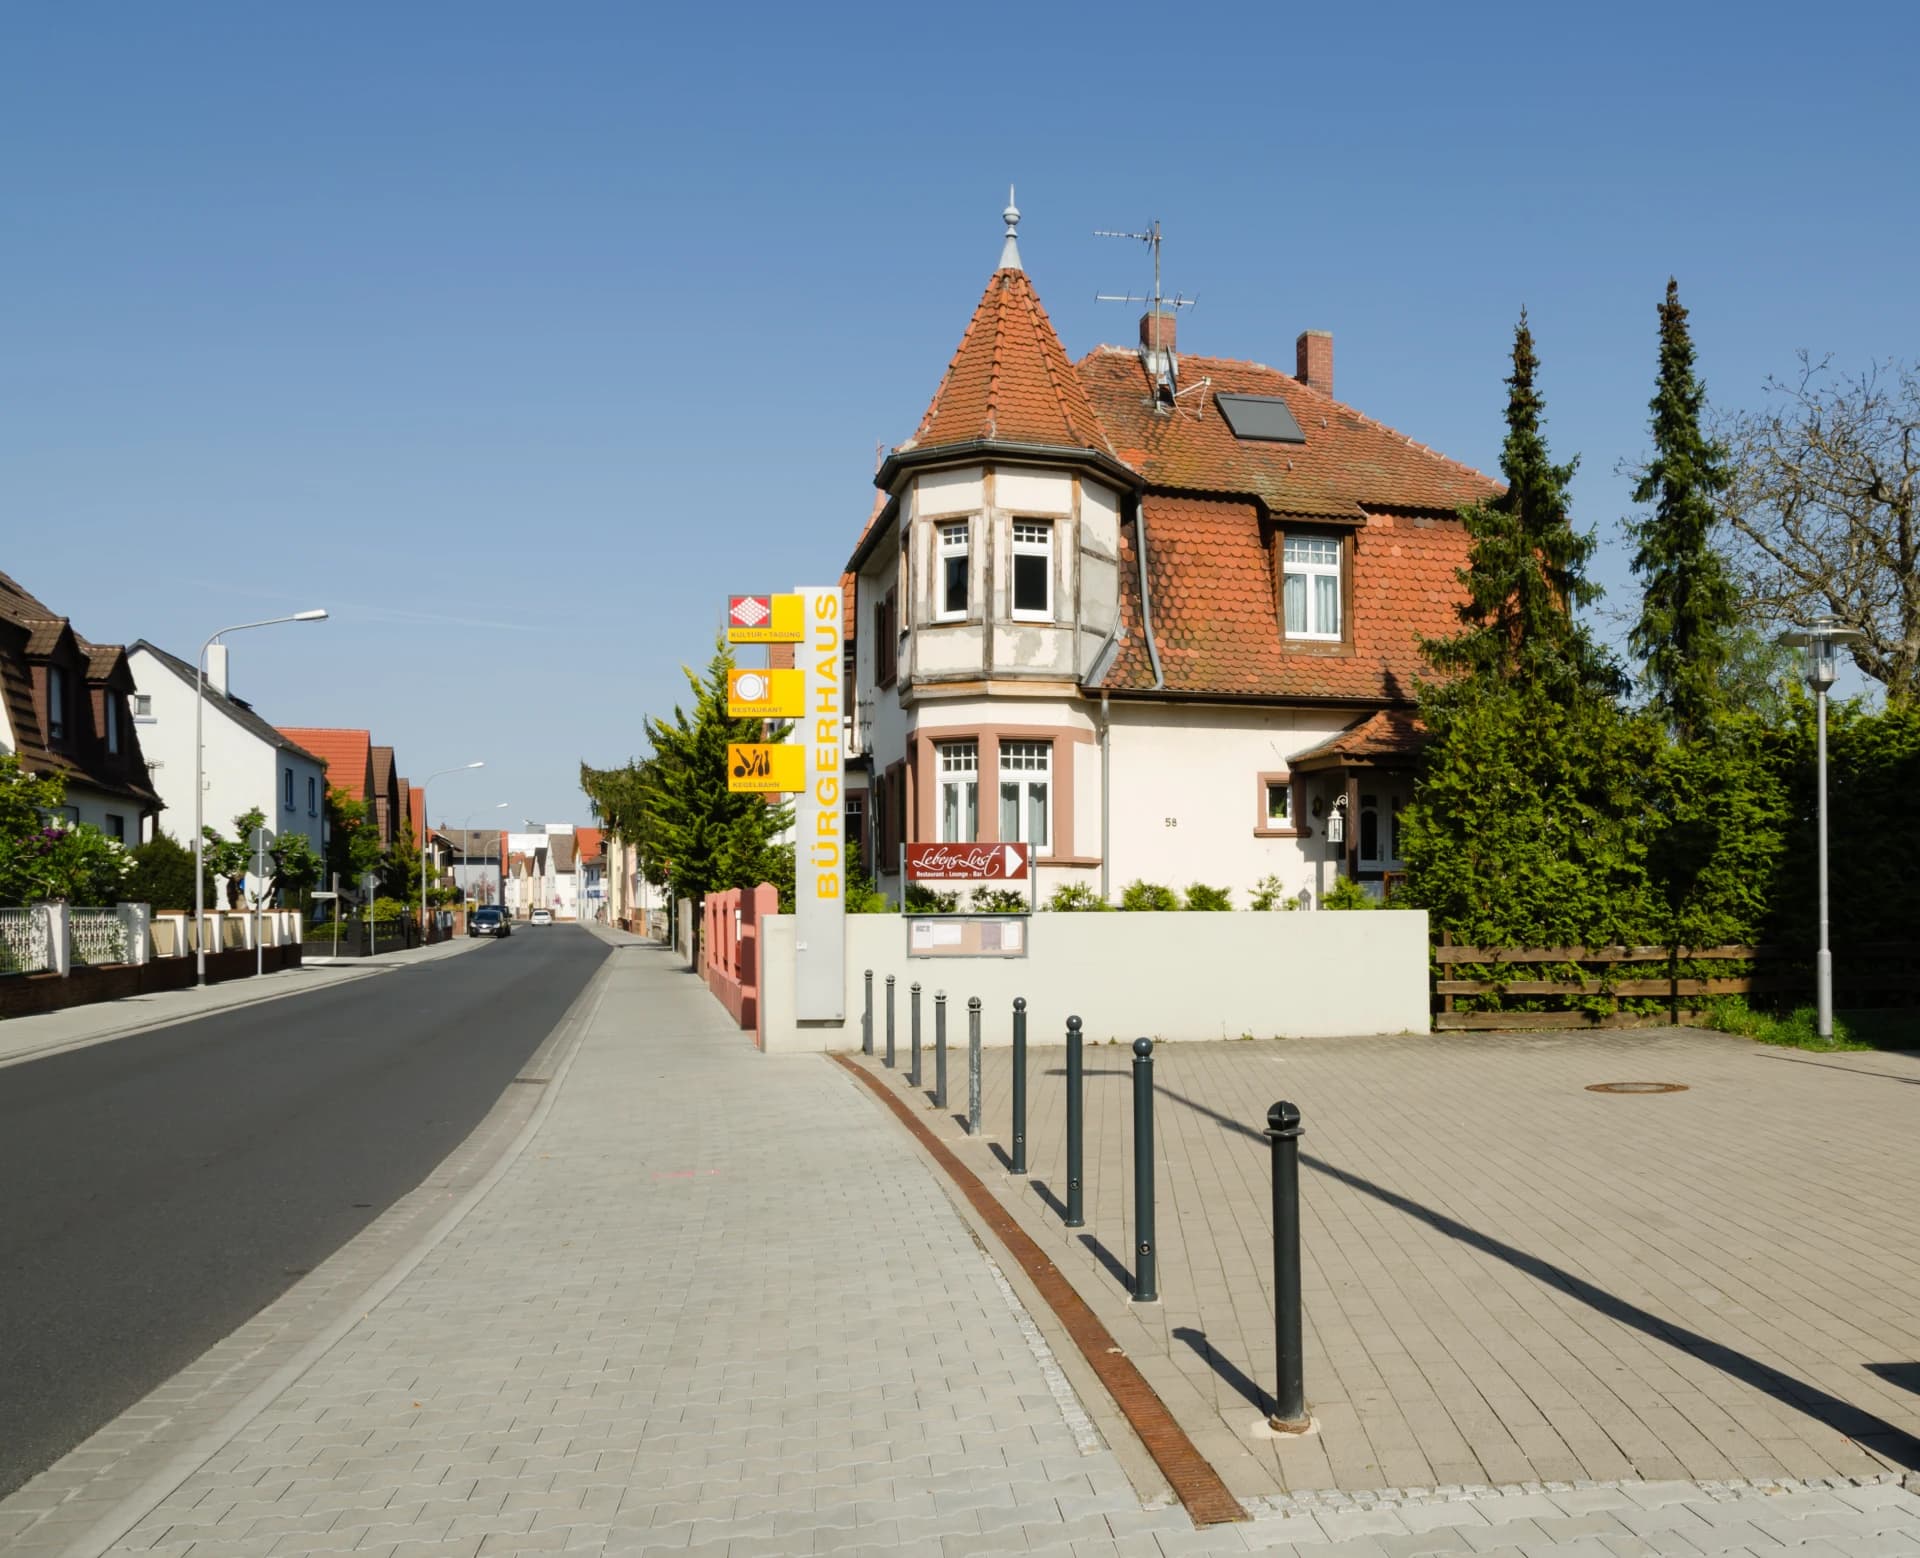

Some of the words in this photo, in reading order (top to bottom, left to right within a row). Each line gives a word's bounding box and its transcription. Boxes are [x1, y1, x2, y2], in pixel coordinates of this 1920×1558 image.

[811, 594, 839, 899] BÜRGERHAUS
[1165, 817, 1177, 828] 58
[949, 871, 968, 879] Lounge
